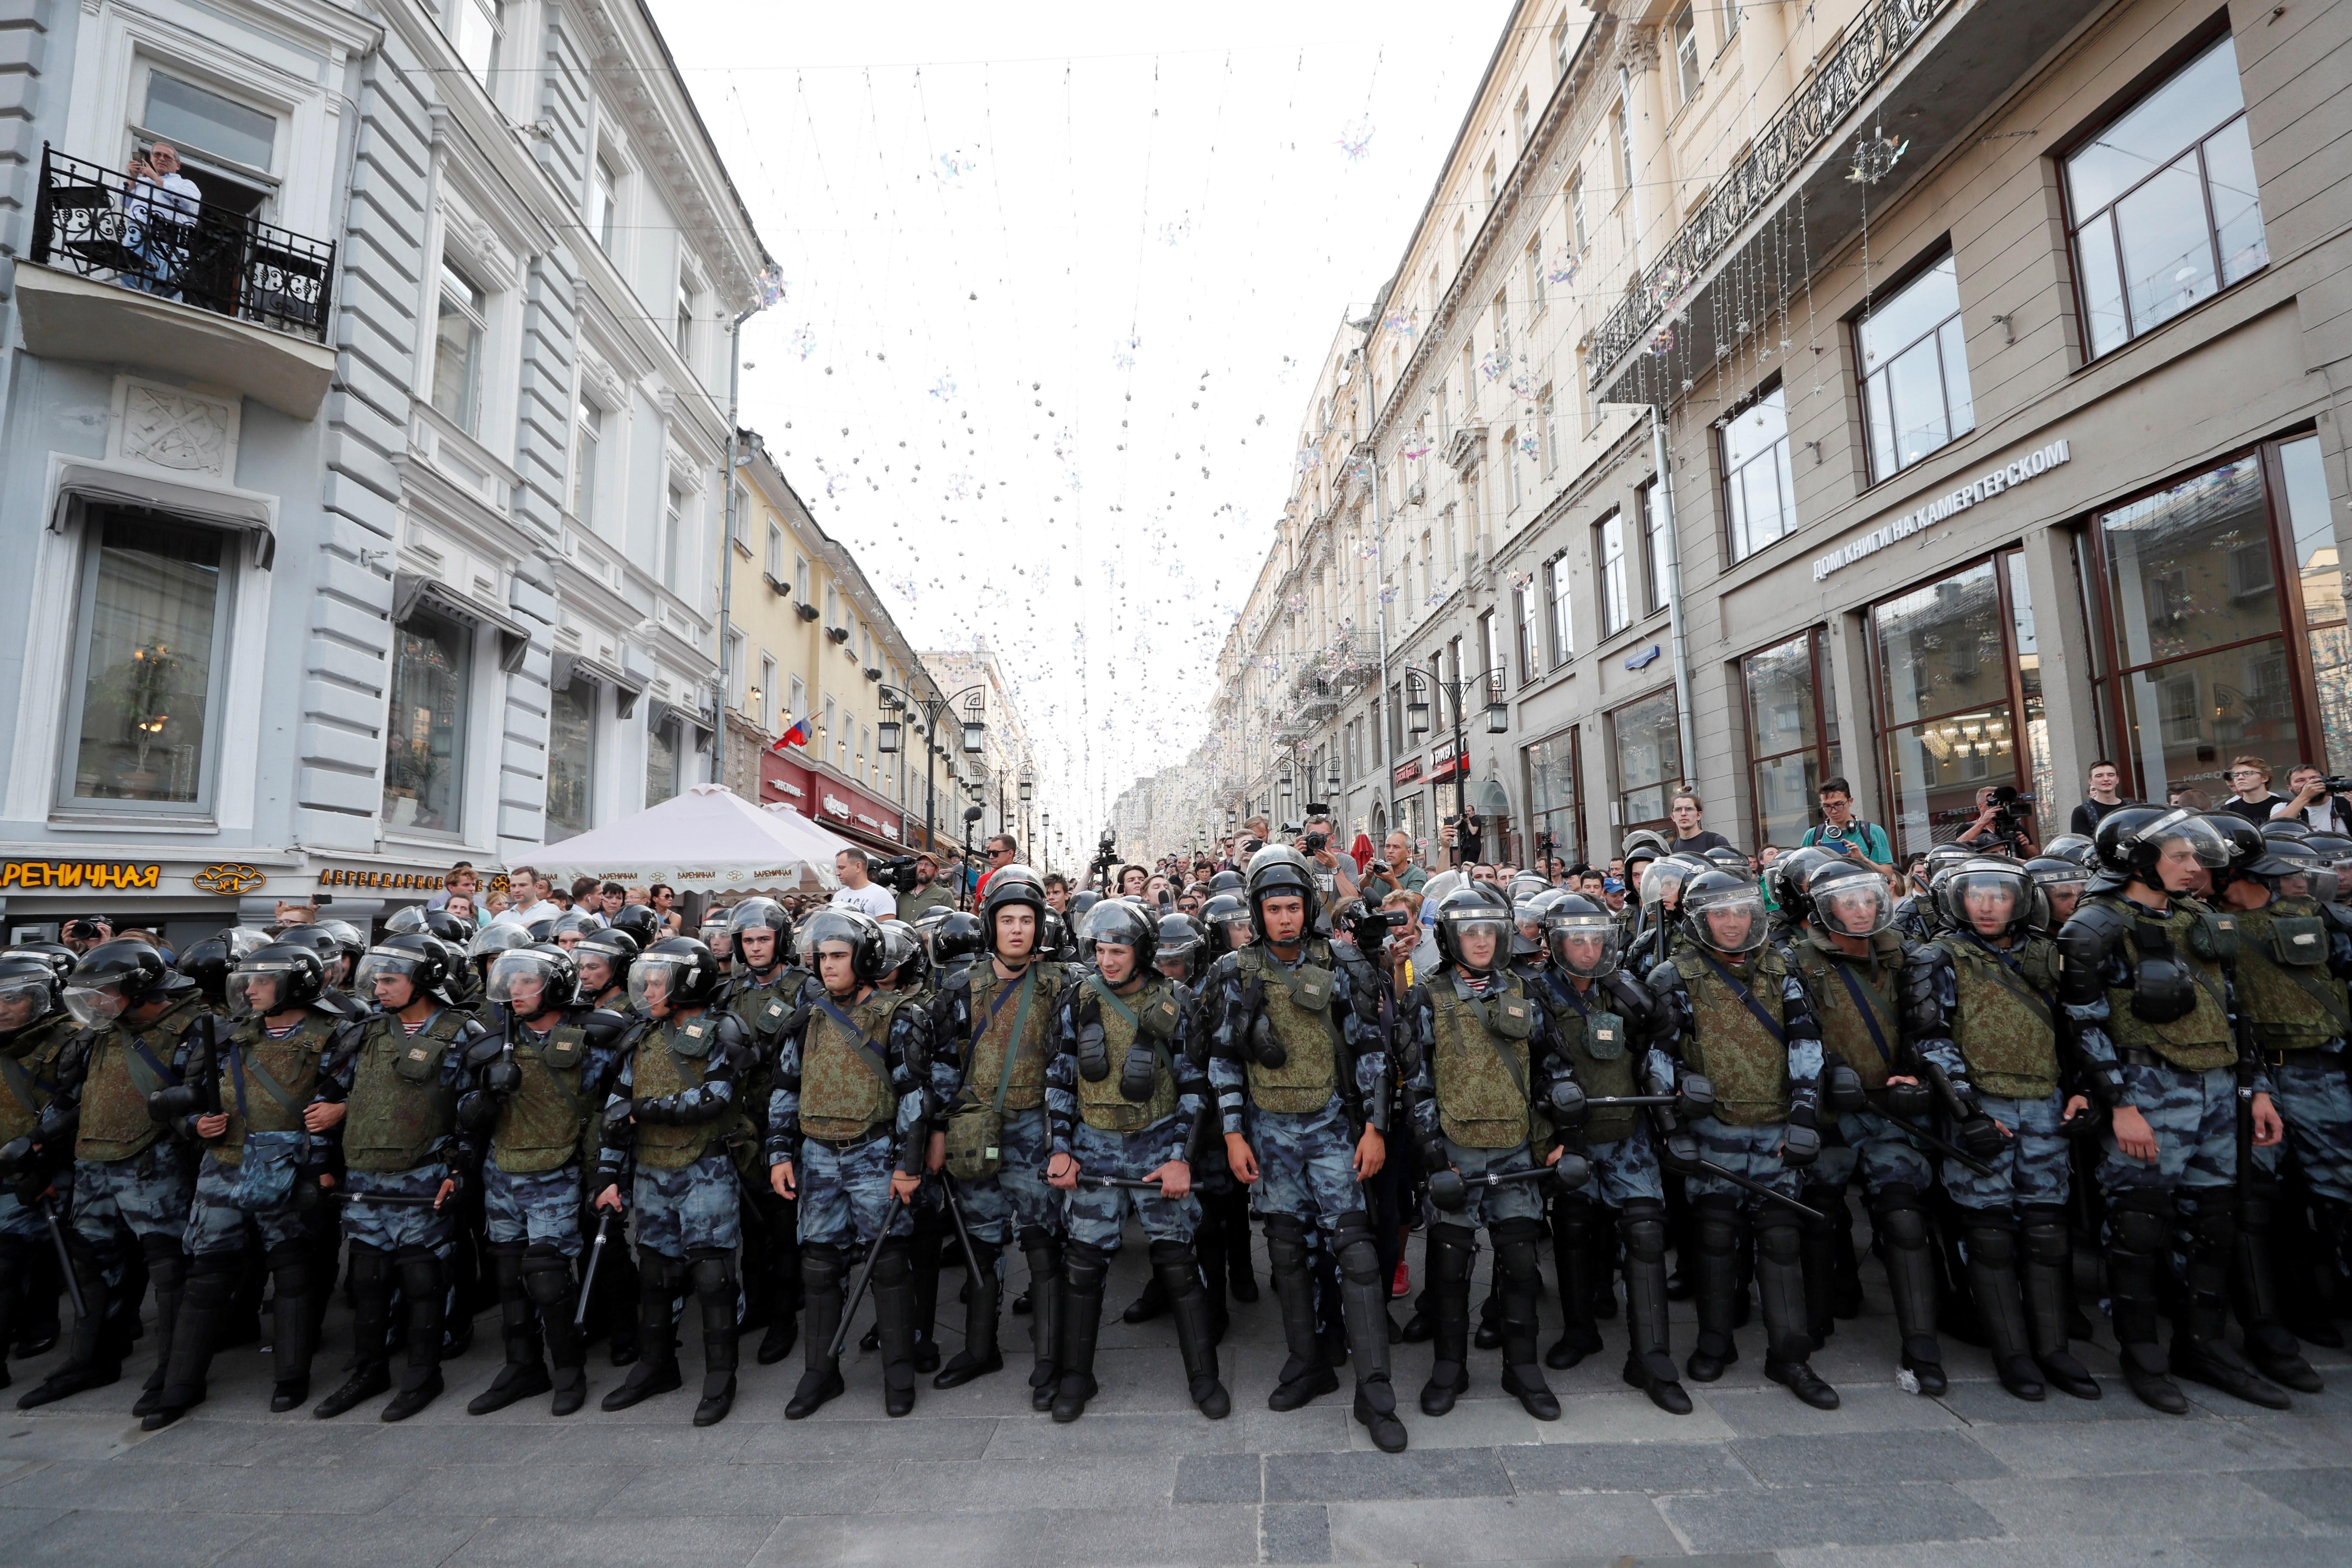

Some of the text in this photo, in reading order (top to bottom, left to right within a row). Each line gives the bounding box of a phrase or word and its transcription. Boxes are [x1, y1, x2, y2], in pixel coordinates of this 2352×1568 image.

[1813, 439, 2070, 582] ДОМ КНИГИ НА КАМЕРГЕРСКОМ
[1435, 738, 1464, 764] БУРГЕР КГ
[775, 779, 801, 797] РЕСТОРАН
[0, 862, 160, 888] РЕНИЧНАЯ
[319, 868, 444, 890] ЛЕГЕНДАРНОЕ
[753, 869, 792, 877] ВАРЕНИЧНАЯ
